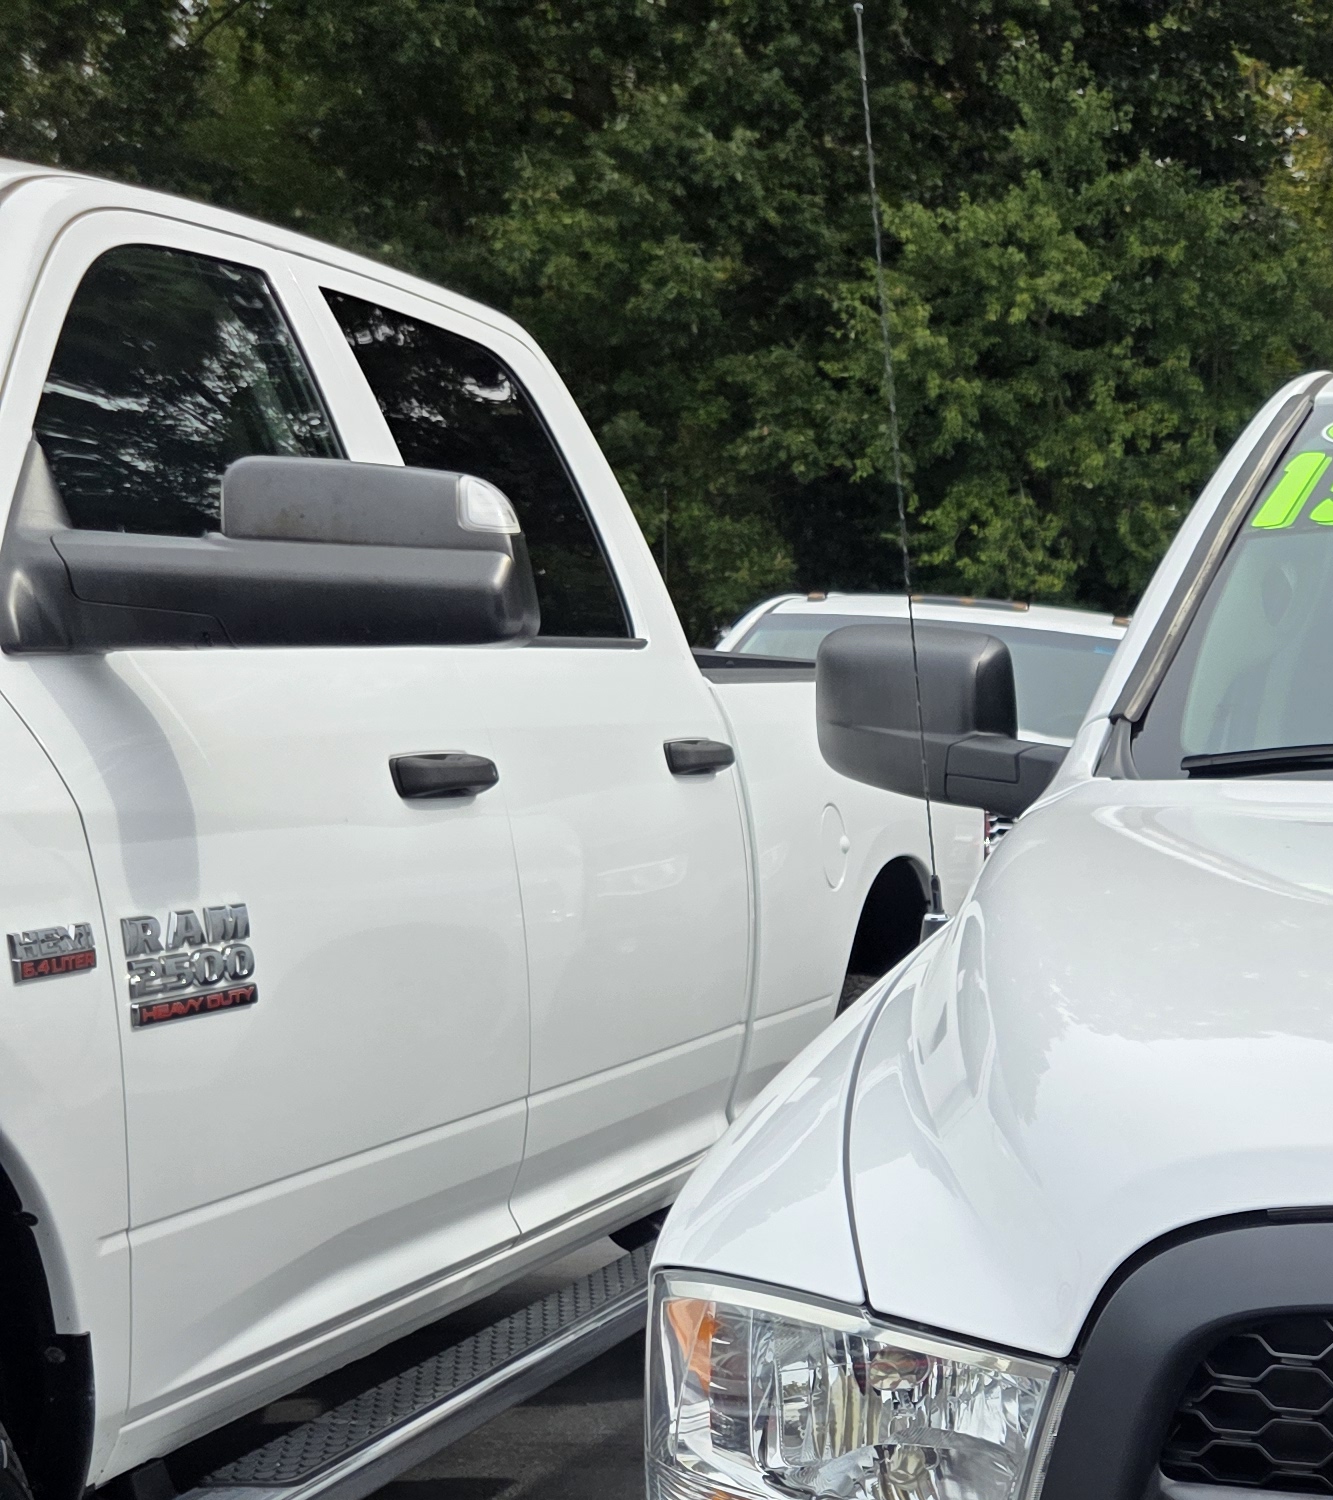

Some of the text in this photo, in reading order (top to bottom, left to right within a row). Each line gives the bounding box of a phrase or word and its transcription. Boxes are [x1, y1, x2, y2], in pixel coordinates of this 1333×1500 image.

[7, 922, 96, 960] HEMI
[120, 903, 250, 957] RAM
[52, 950, 96, 974] LITER
[128, 943, 254, 1001] 2500
[141, 986, 255, 1022] HEAVY DUTY
